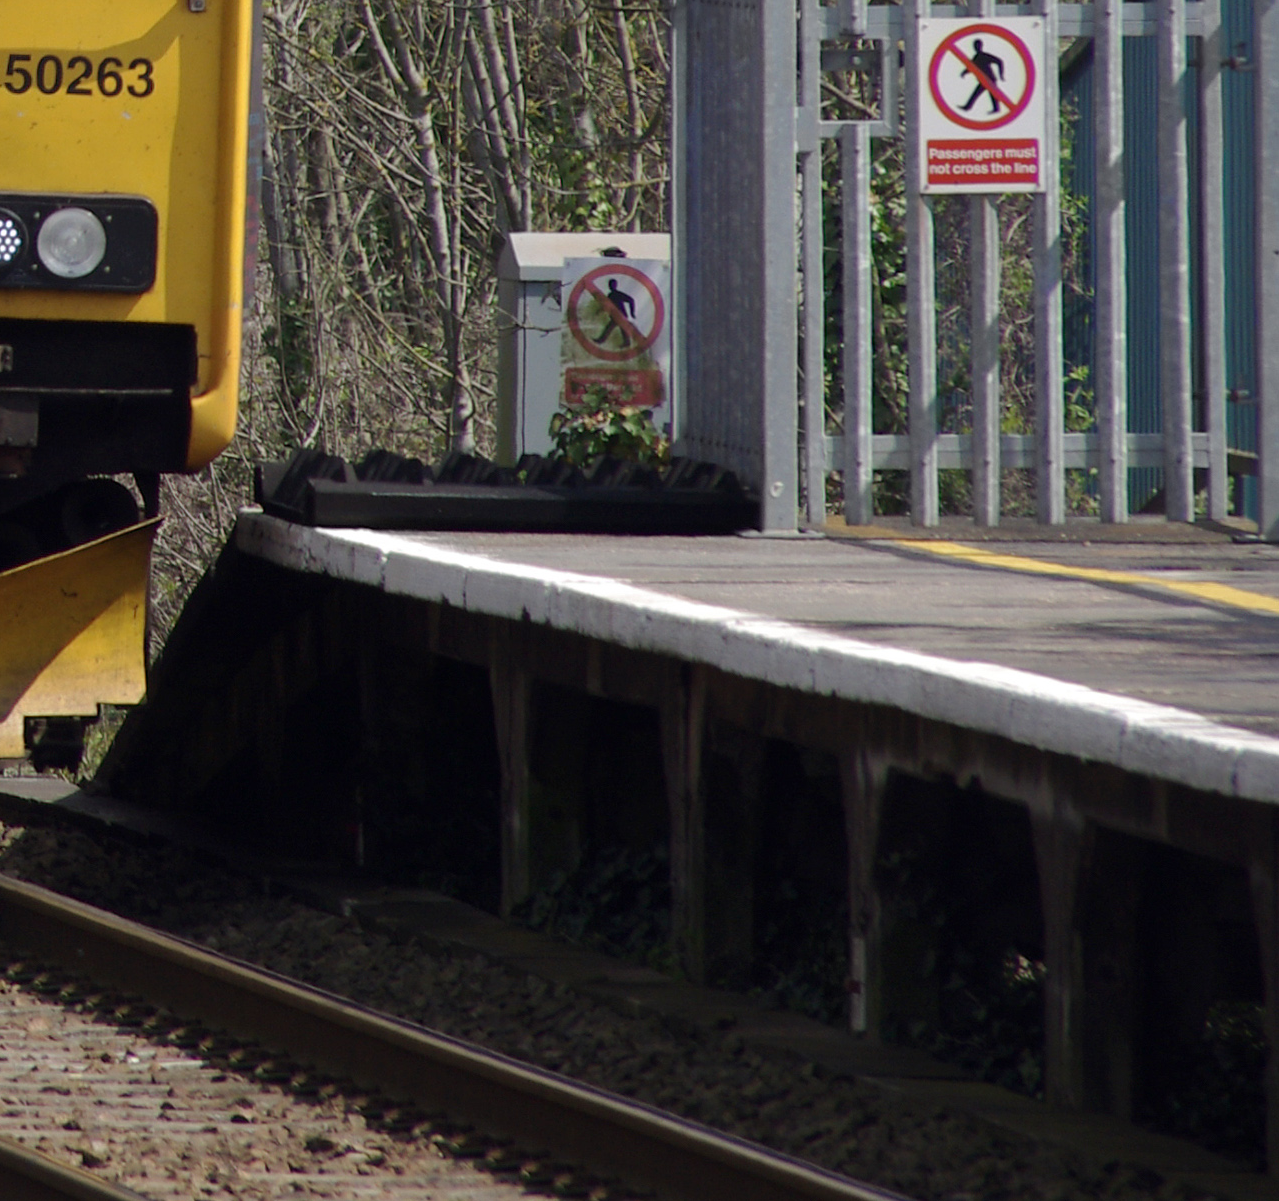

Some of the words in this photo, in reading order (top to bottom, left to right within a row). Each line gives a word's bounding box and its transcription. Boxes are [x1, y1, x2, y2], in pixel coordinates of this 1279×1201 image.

[929, 148, 1002, 161] Passengers
[1005, 147, 1036, 158] must
[929, 163, 950, 174] not
[952, 164, 989, 174] cross
[991, 162, 1012, 174] the
[1014, 162, 1037, 174] line
